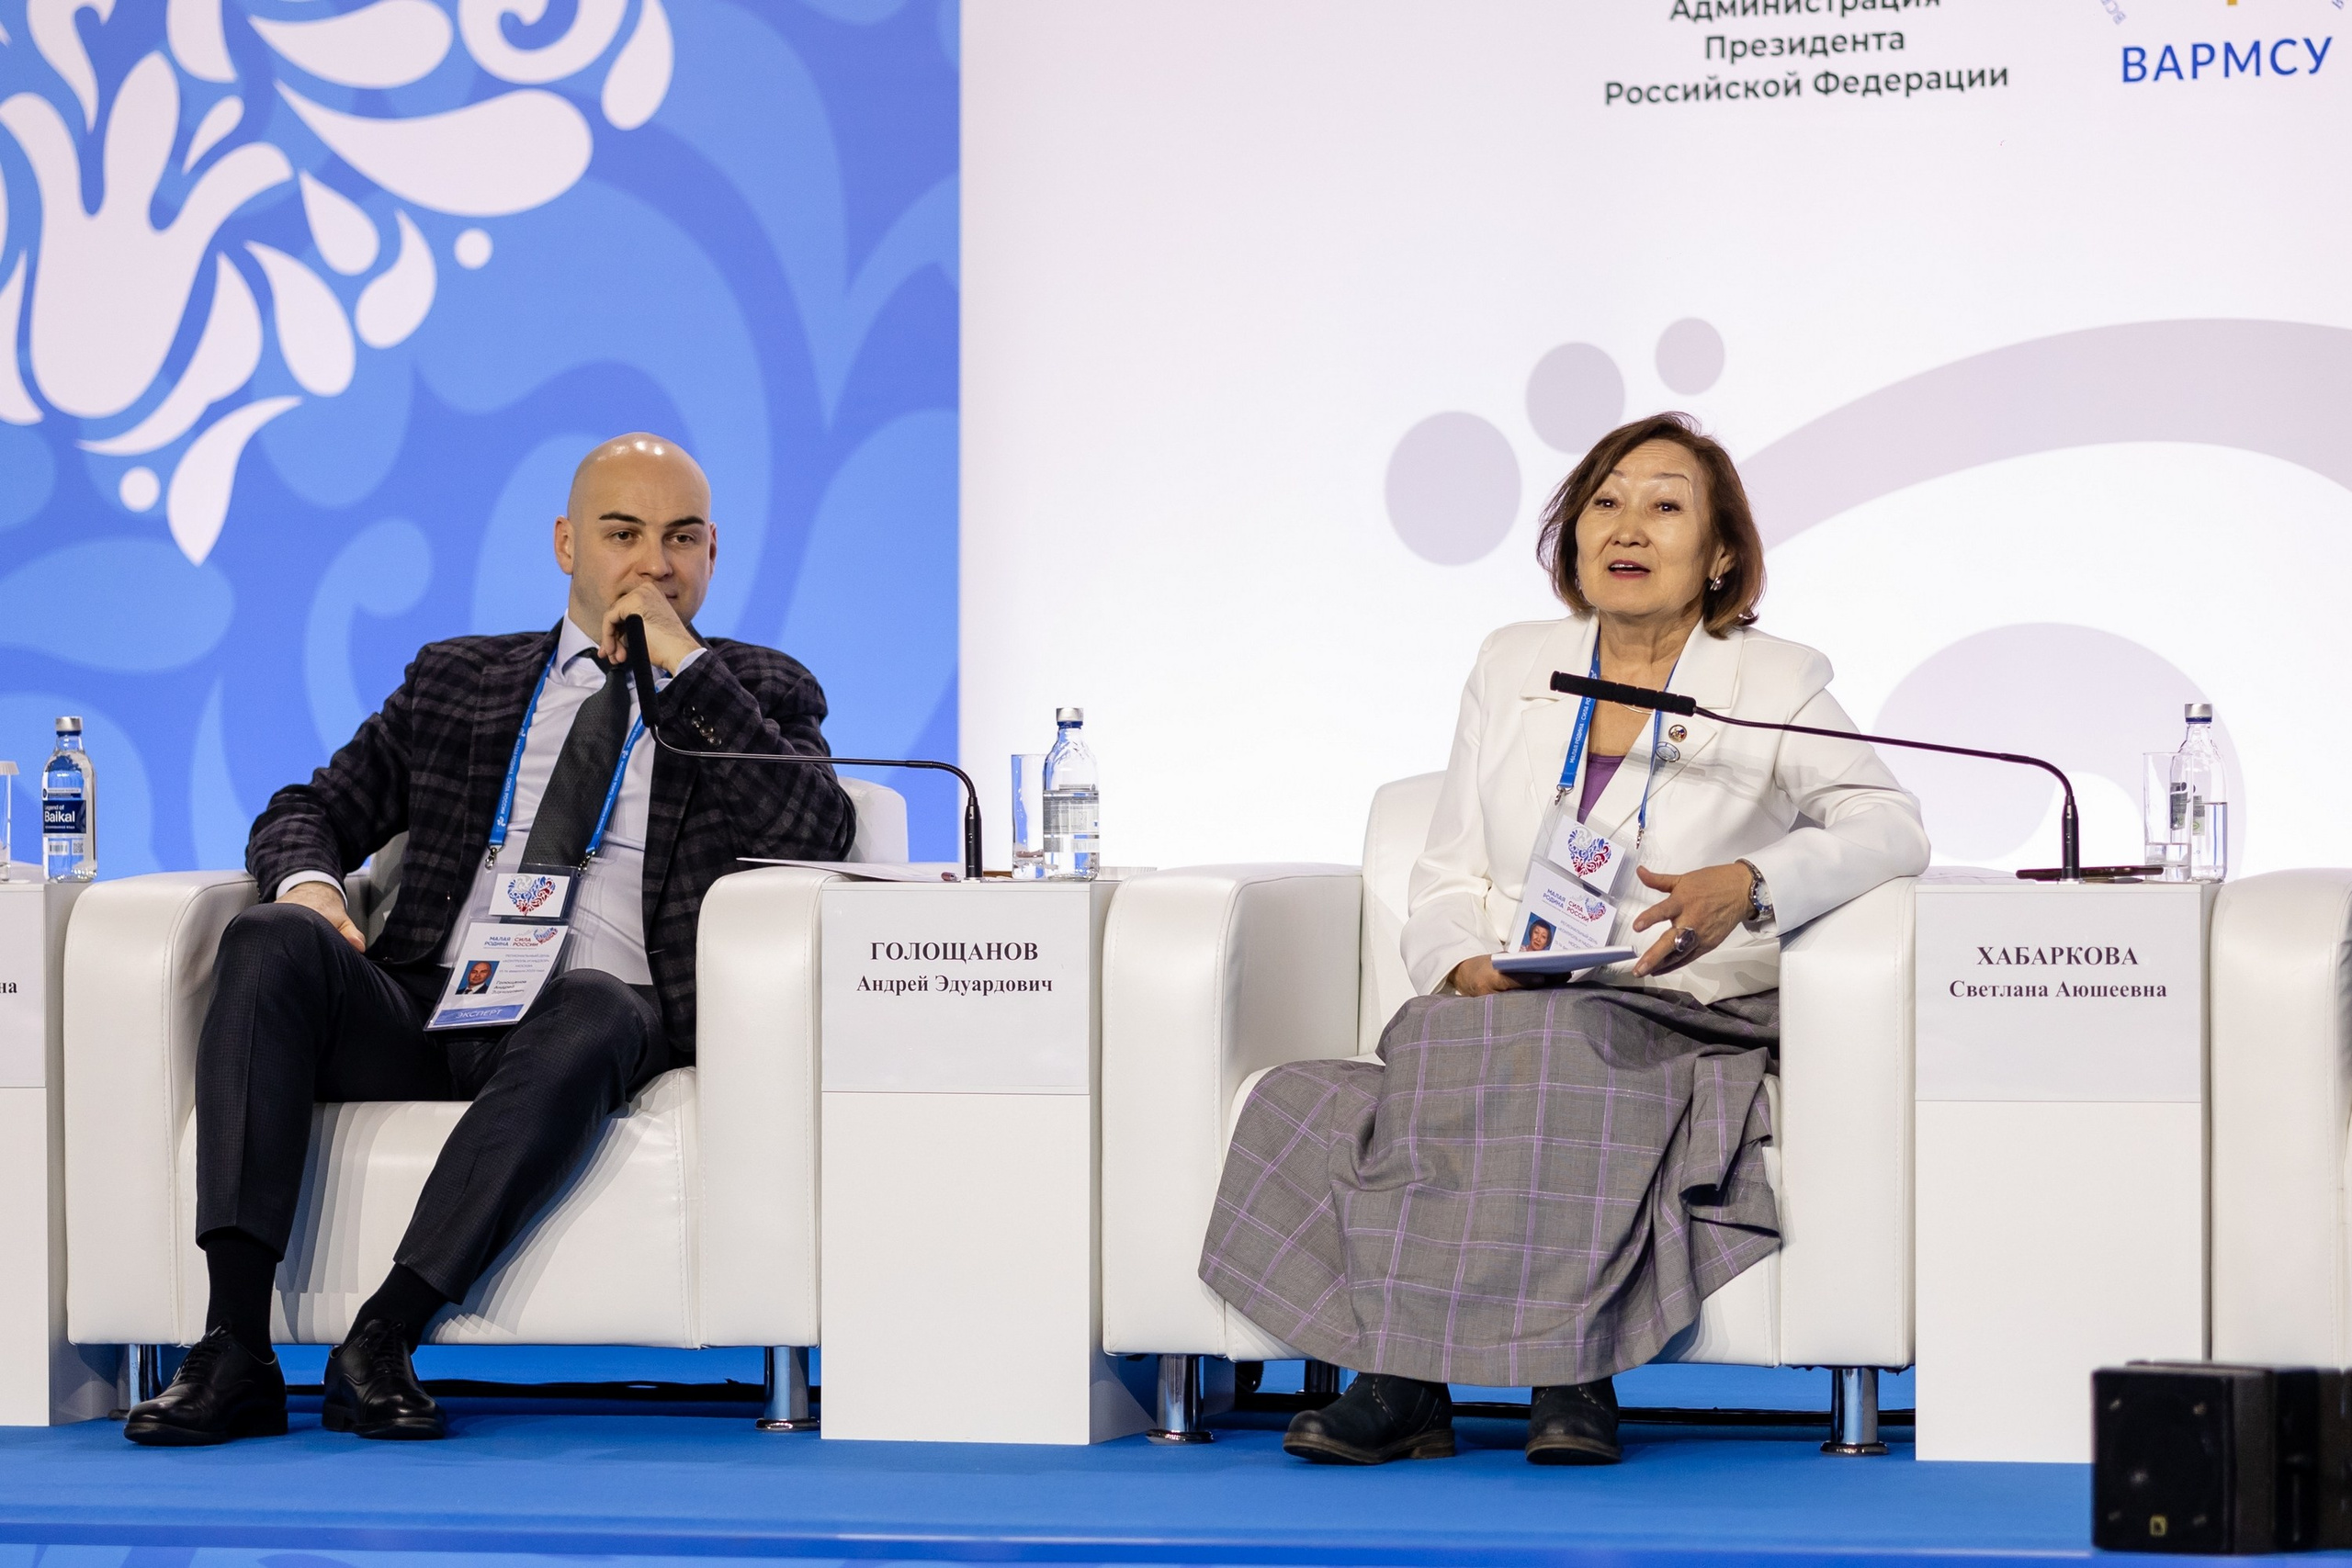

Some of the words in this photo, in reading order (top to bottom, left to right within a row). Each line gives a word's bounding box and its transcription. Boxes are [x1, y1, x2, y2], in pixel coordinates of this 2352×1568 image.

[1669, 0, 1940, 23] Администрац
[1704, 30, 1905, 64] Президента
[2122, 36, 2333, 84] ВАРМСУ
[1604, 71, 1803, 106] Российской
[1814, 67, 2009, 97] Федерации
[1580, 705, 1589, 721] СИЛА
[44, 810, 75, 823] Baikal
[1543, 892, 1564, 908] РОДИНА
[1547, 888, 1566, 902] МАЛАЯ
[1566, 906, 1589, 922] РОССИИ
[1567, 900, 1583, 913] СИЛА
[870, 942, 1039, 964] ГОЛОЩАНОВ
[1976, 946, 2139, 965] ХАБАРКОВА
[856, 975, 928, 997] Андрей
[935, 975, 1053, 997] Эдуардович
[1949, 979, 2049, 998] Светлана
[2055, 980, 2167, 998] Аюшеевна
[456, 1009, 503, 1019] ЭКСПЕРТ
